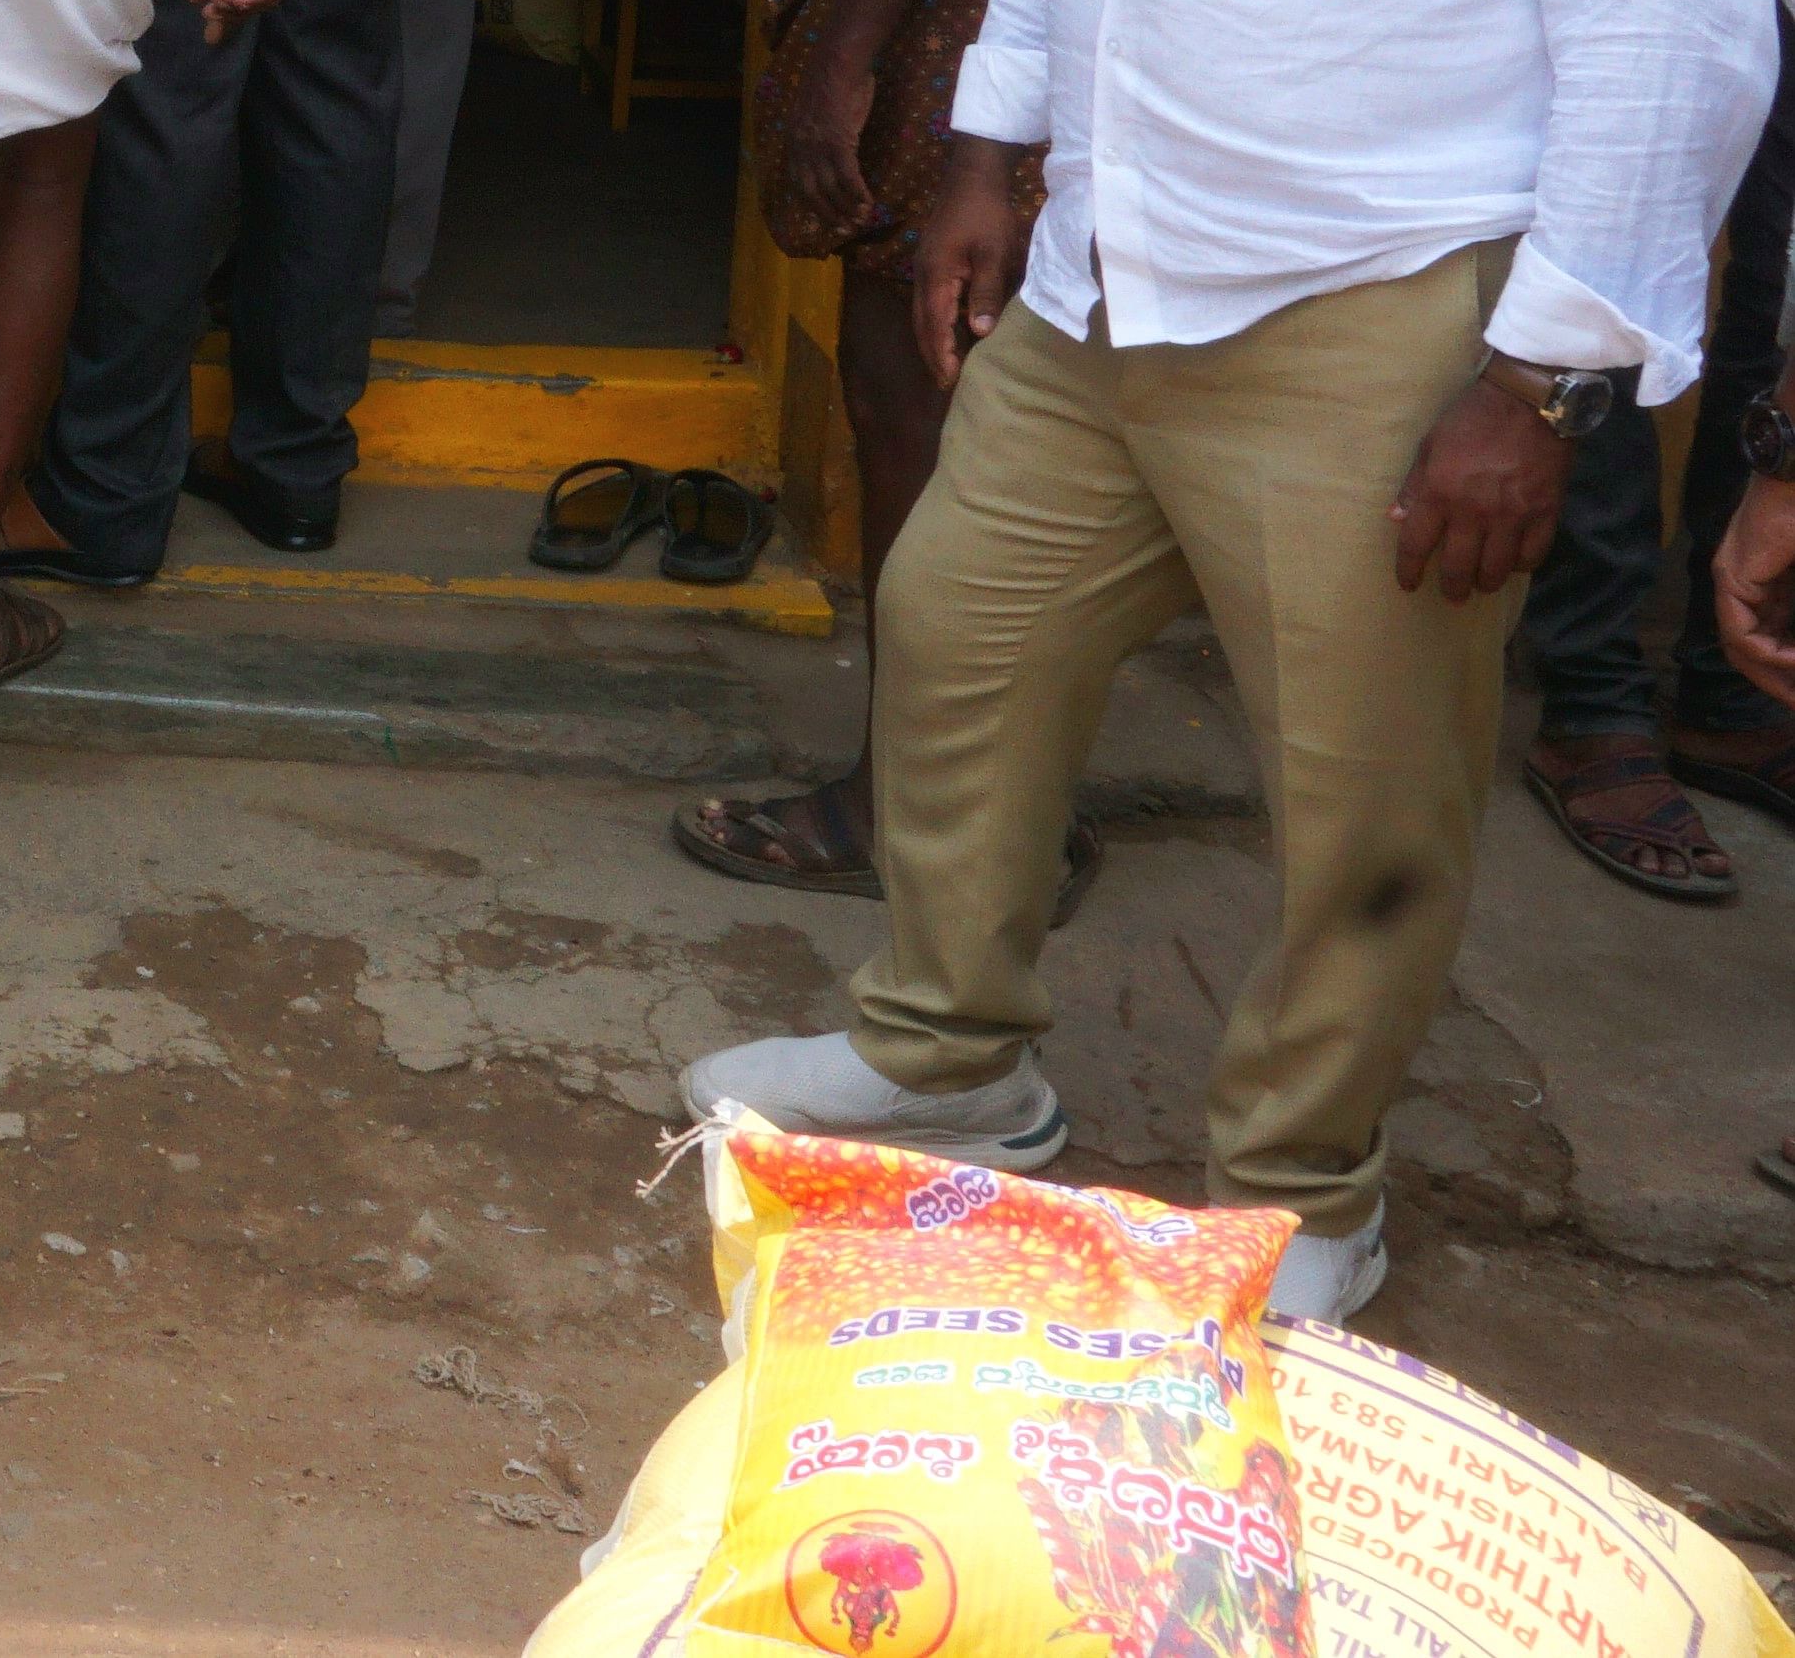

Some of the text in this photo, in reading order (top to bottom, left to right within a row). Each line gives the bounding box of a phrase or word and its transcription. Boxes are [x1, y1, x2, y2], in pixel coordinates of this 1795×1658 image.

[909, 1168, 995, 1229] ಬೀಜ
[828, 1308, 1246, 1399] PUSES SEEDS
[856, 1364, 948, 1388] ಬೀಜ
[1270, 1366, 1313, 1399] 10
[1329, 1390, 1409, 1438] 583
[1448, 1443, 1649, 1594] BALLARI
[1309, 1514, 1541, 1651] PRODUCED
[1433, 1517, 1637, 1658] ARTHIK
